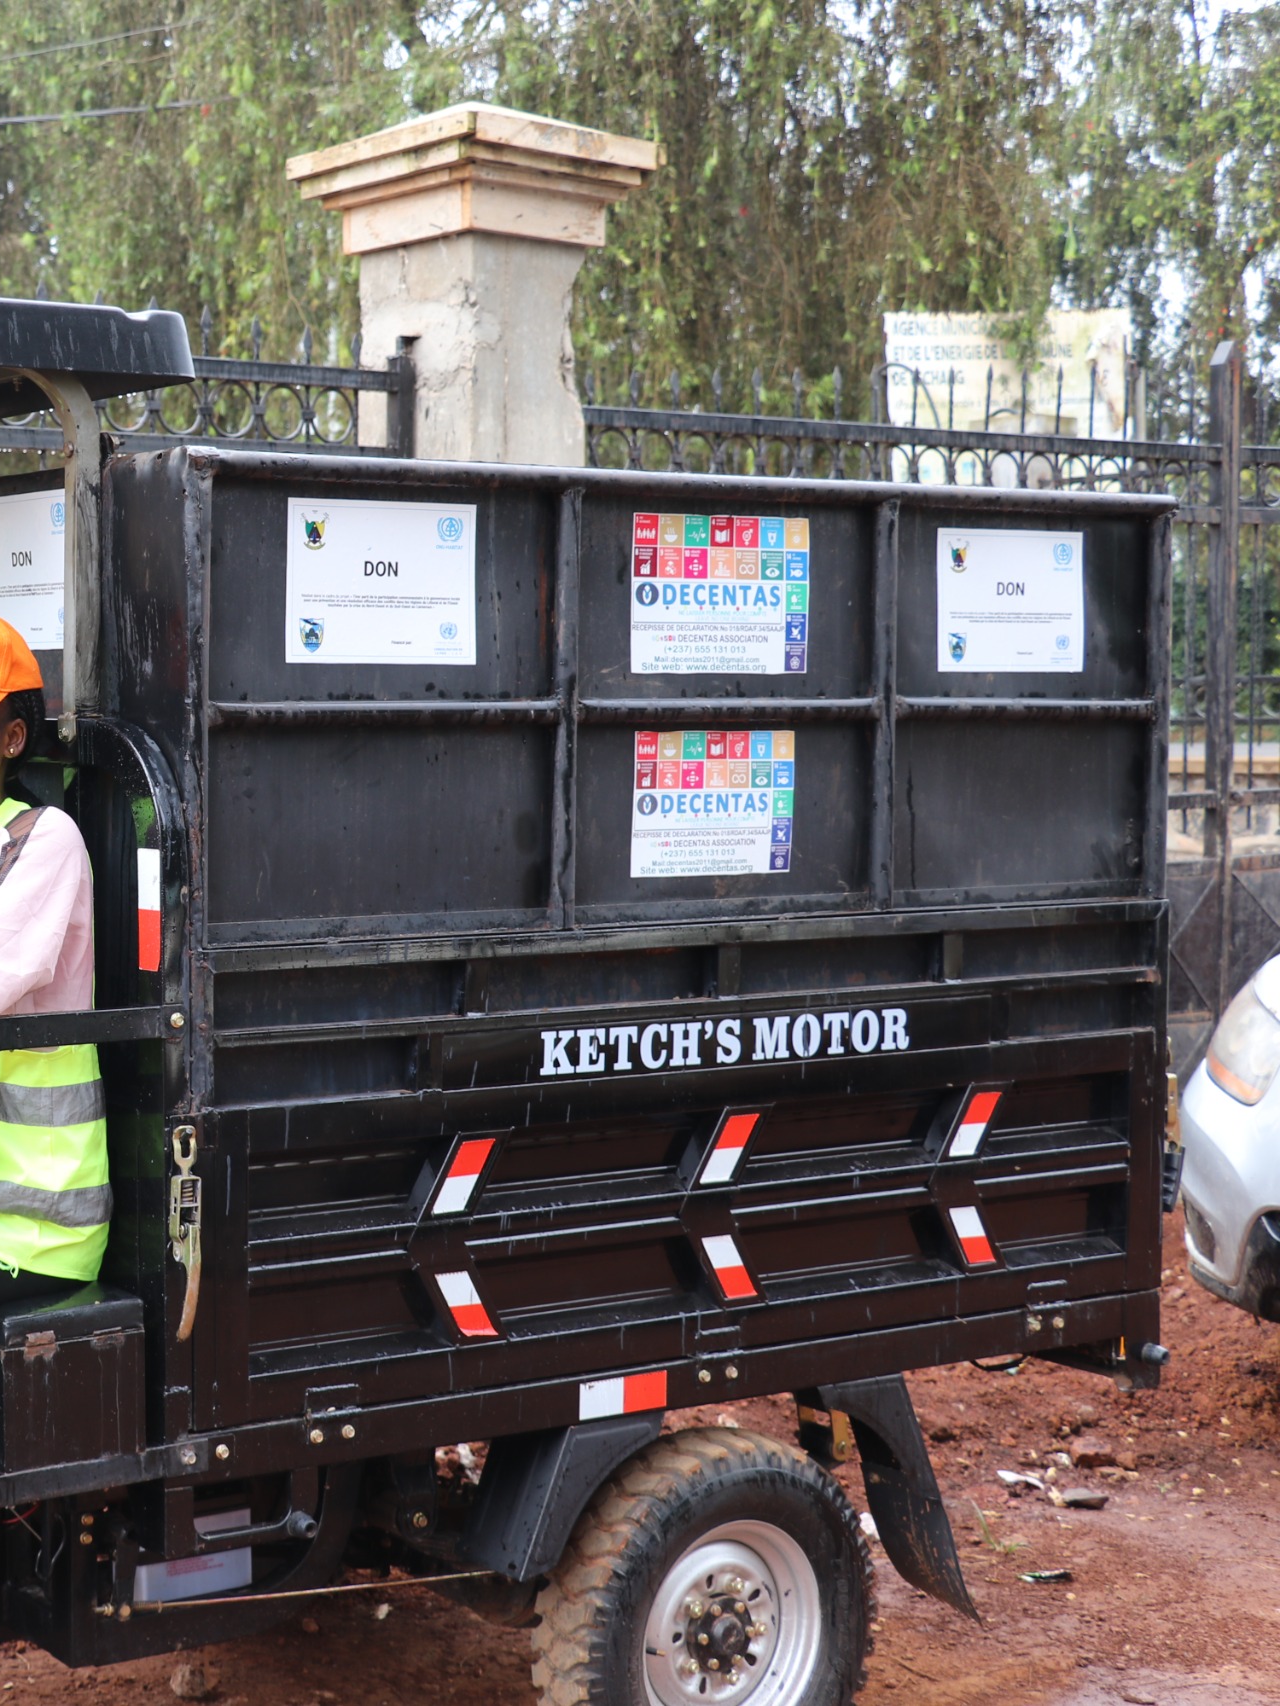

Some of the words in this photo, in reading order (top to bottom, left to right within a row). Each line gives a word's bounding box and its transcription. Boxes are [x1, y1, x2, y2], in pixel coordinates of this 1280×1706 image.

[892, 320, 938, 336] AGENCE
[893, 345, 905, 360] ET
[908, 345, 922, 360] DE
[11, 550, 33, 567] DON
[364, 561, 399, 577] DON
[662, 584, 780, 607] DECENTAS
[996, 581, 1025, 596] DON
[678, 634, 718, 642] DECENTAS
[720, 635, 768, 643] ASSOCIATION
[664, 645, 692, 654] (+237)
[694, 645, 711, 653] 655
[641, 662, 659, 671] Site
[661, 662, 684, 670] web:
[686, 662, 767, 673] www.decentas.org
[661, 793, 768, 814] DECENTAS
[674, 839, 710, 847] DECENTAS
[712, 838, 756, 846] ASSOCIATION
[661, 850, 686, 858] (+237)
[640, 866, 657, 875] Site
[680, 864, 753, 874] www.decentas.org
[540, 1018, 741, 1076] KETCH'S
[752, 1008, 910, 1061] MOTOR
